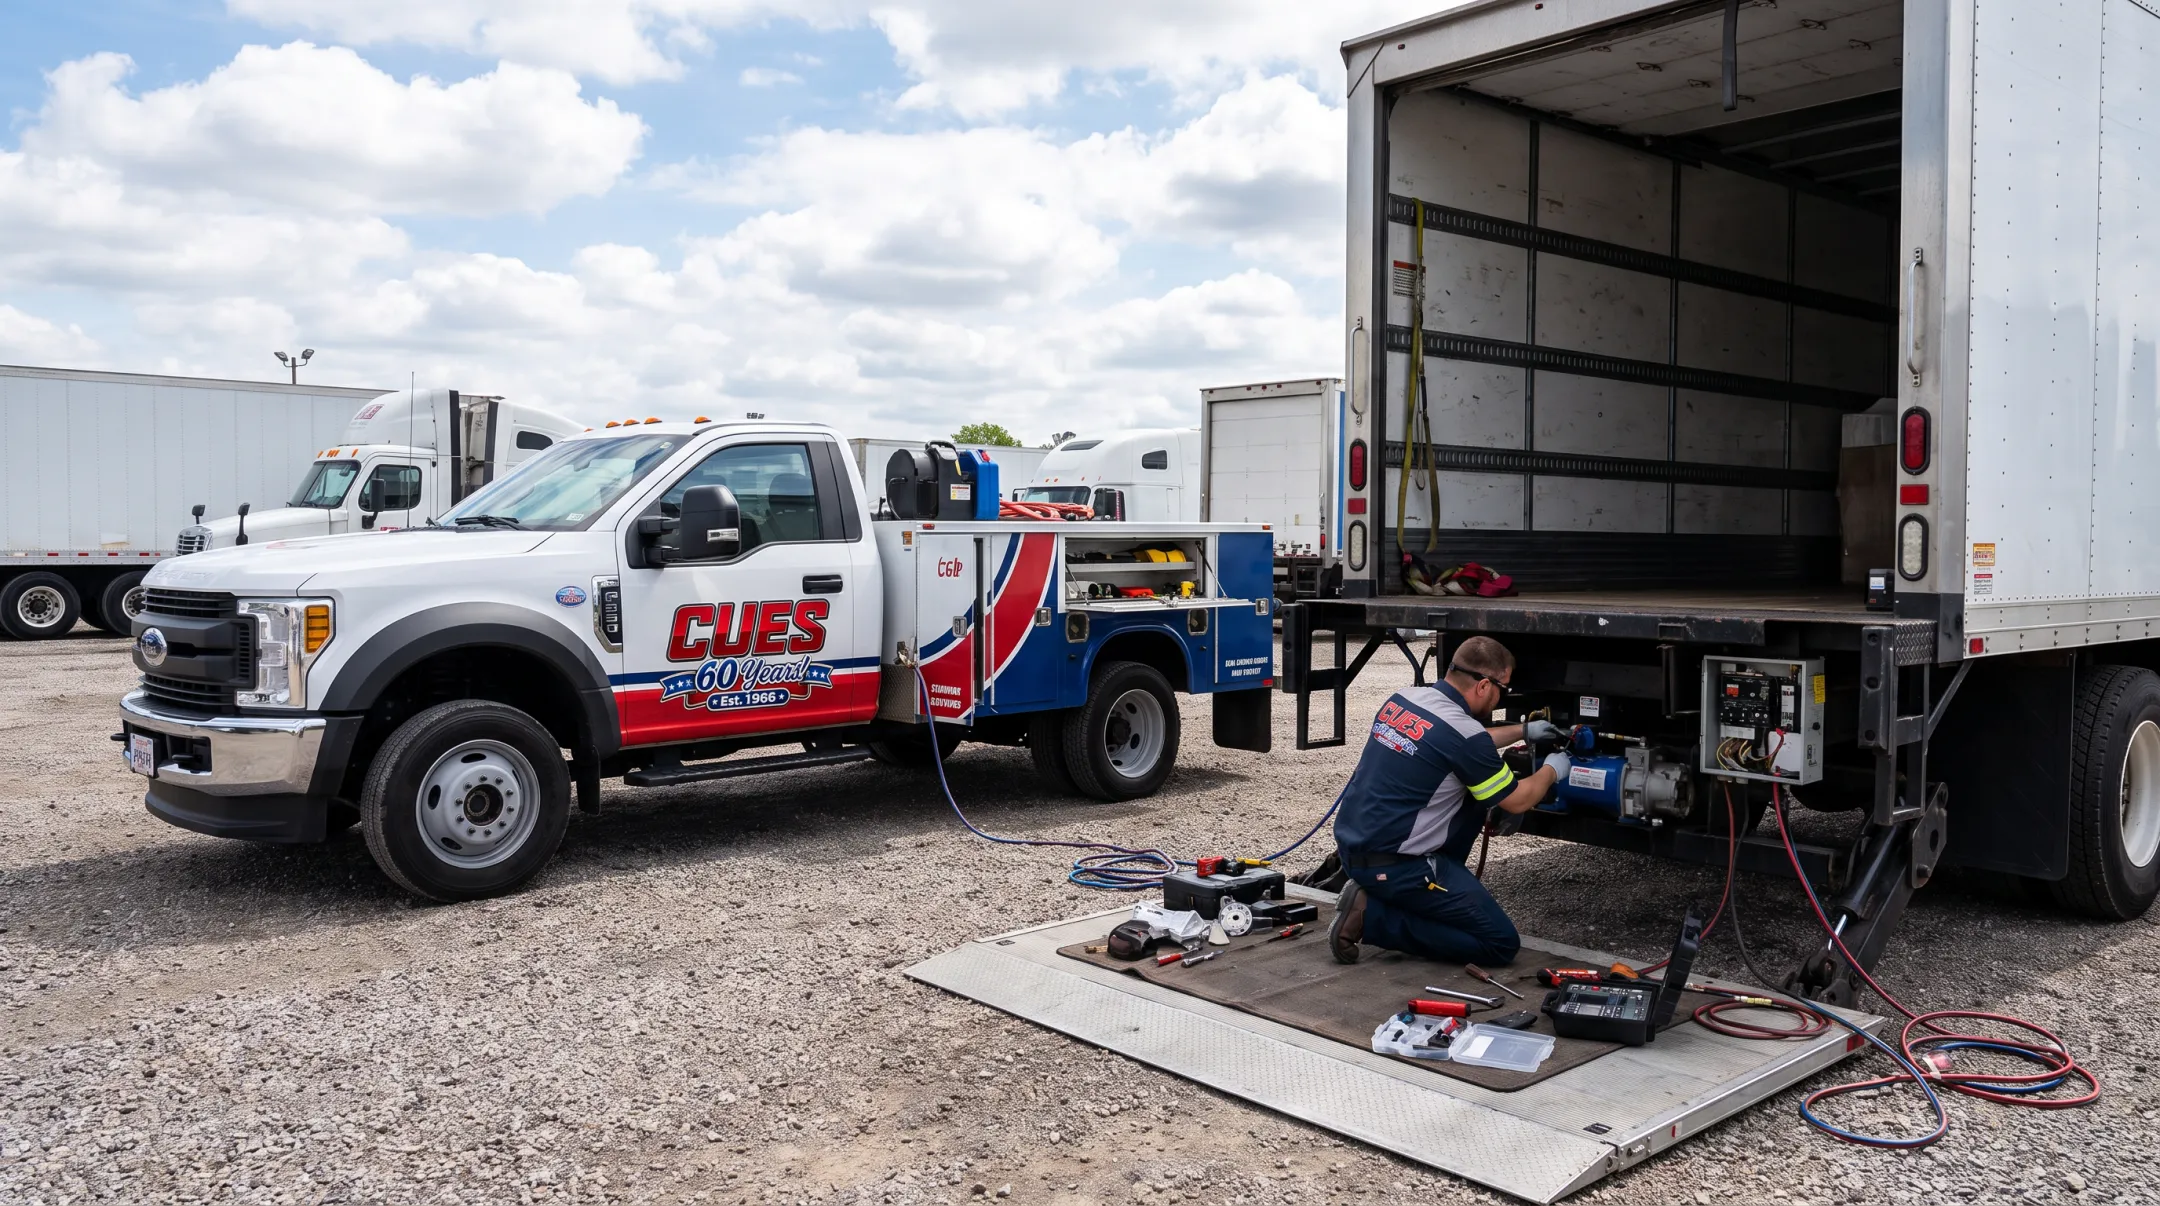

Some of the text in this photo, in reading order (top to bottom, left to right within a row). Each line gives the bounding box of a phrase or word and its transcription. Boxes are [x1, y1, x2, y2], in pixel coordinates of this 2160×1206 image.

[666, 599, 830, 662] CUES
[695, 654, 811, 692] 60 Years!
[720, 691, 776, 707] Est. 1966
[1378, 701, 1433, 741] CUES
